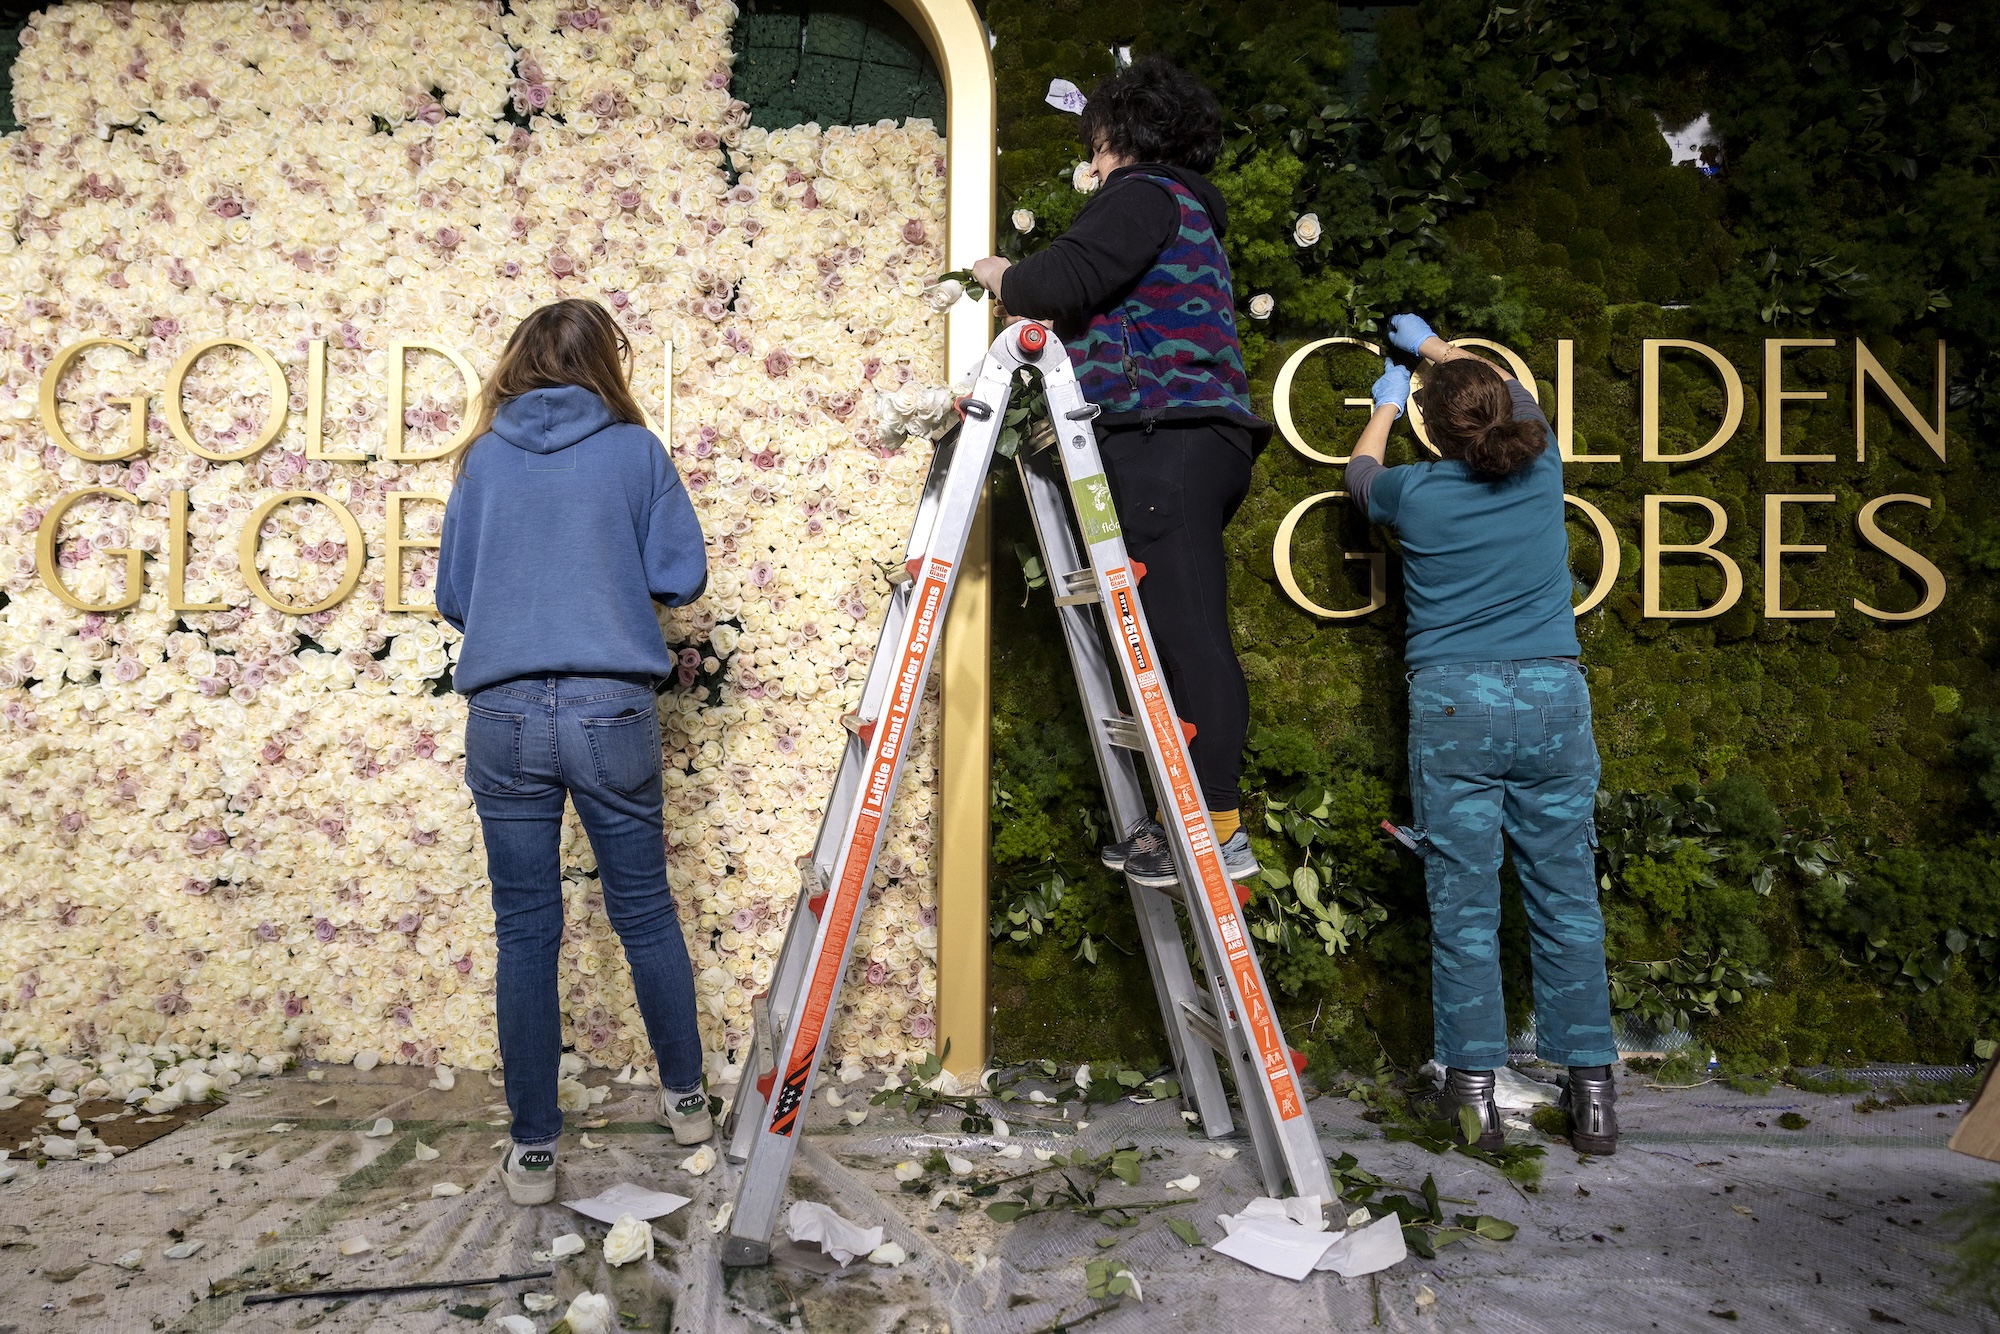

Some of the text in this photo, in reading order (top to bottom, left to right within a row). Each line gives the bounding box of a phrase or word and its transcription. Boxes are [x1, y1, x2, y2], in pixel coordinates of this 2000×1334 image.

[38, 338, 673, 463] GOLDN
[1272, 490, 1947, 621] GBES
[929, 569, 946, 579] Giant
[931, 563, 948, 574] Little
[1108, 573, 1126, 582] Little
[1110, 579, 1127, 587] Giant
[1118, 594, 1129, 613] DUTY
[1121, 614, 1141, 648] 250
[1133, 645, 1146, 669] RATED
[867, 762, 891, 807] Little
[880, 715, 905, 760] Giant
[893, 656, 920, 714] Ladder
[910, 585, 941, 655] Systems
[1218, 912, 1236, 924] OSHA
[1227, 938, 1244, 950] ANSI
[680, 1096, 703, 1107] VEJA
[524, 1154, 550, 1163] VEJA
